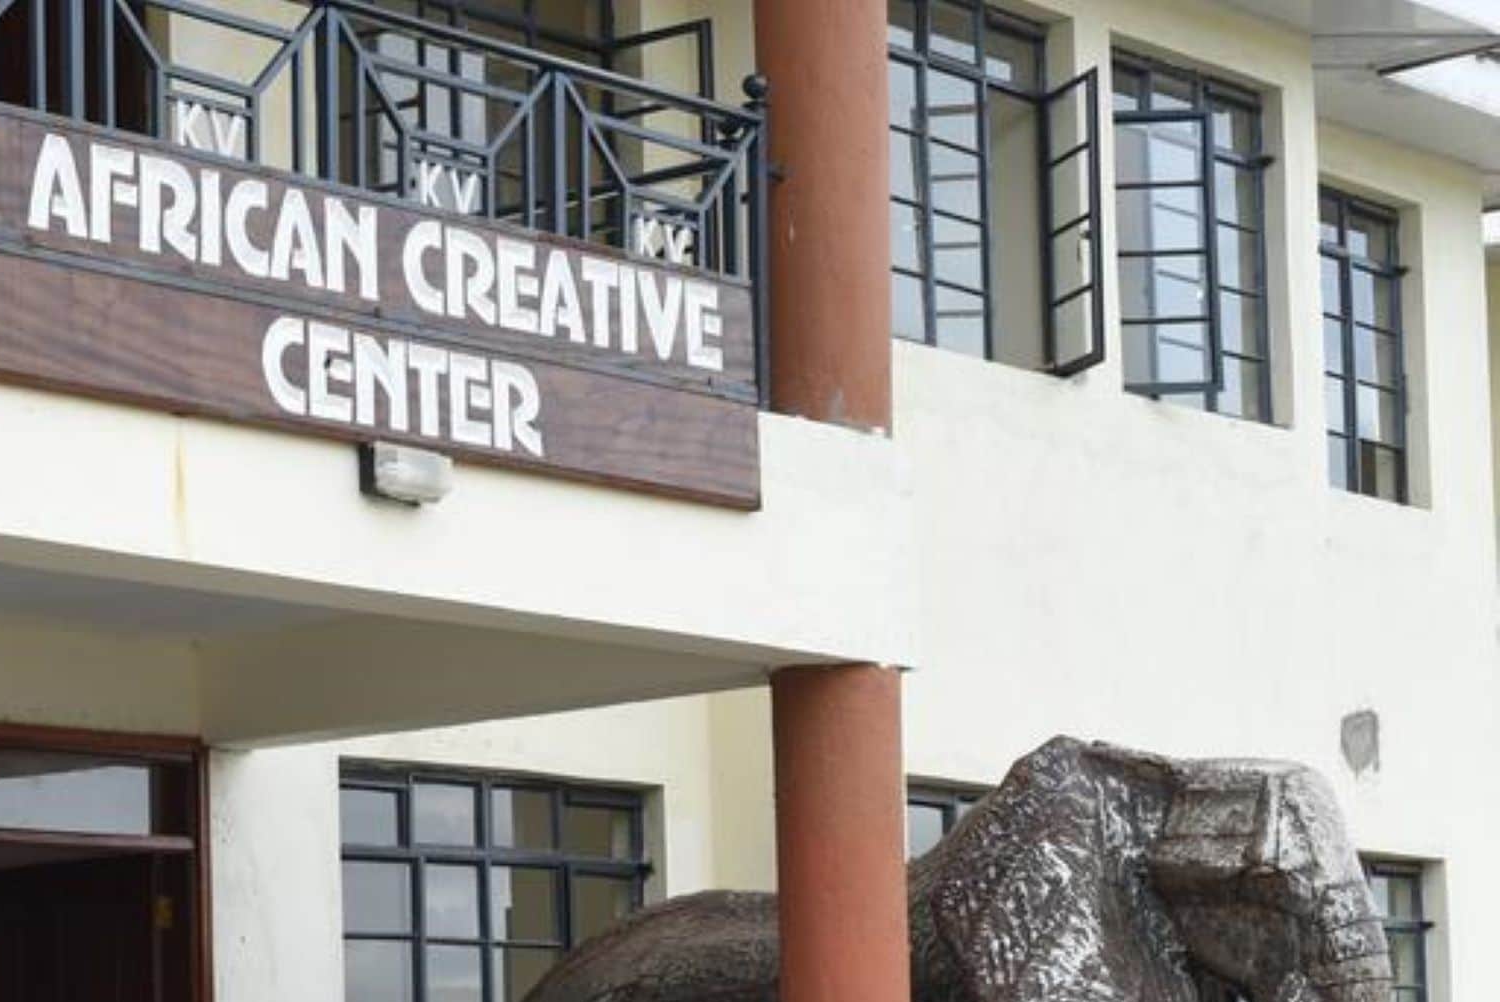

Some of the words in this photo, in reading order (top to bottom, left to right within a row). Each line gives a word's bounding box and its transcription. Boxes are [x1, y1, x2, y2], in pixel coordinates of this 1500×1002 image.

[178, 100, 241, 156] KV
[420, 160, 477, 214] KV
[28, 133, 380, 303] AFRICAN
[402, 219, 724, 371] CREATIVE
[262, 317, 542, 457] CENTER
